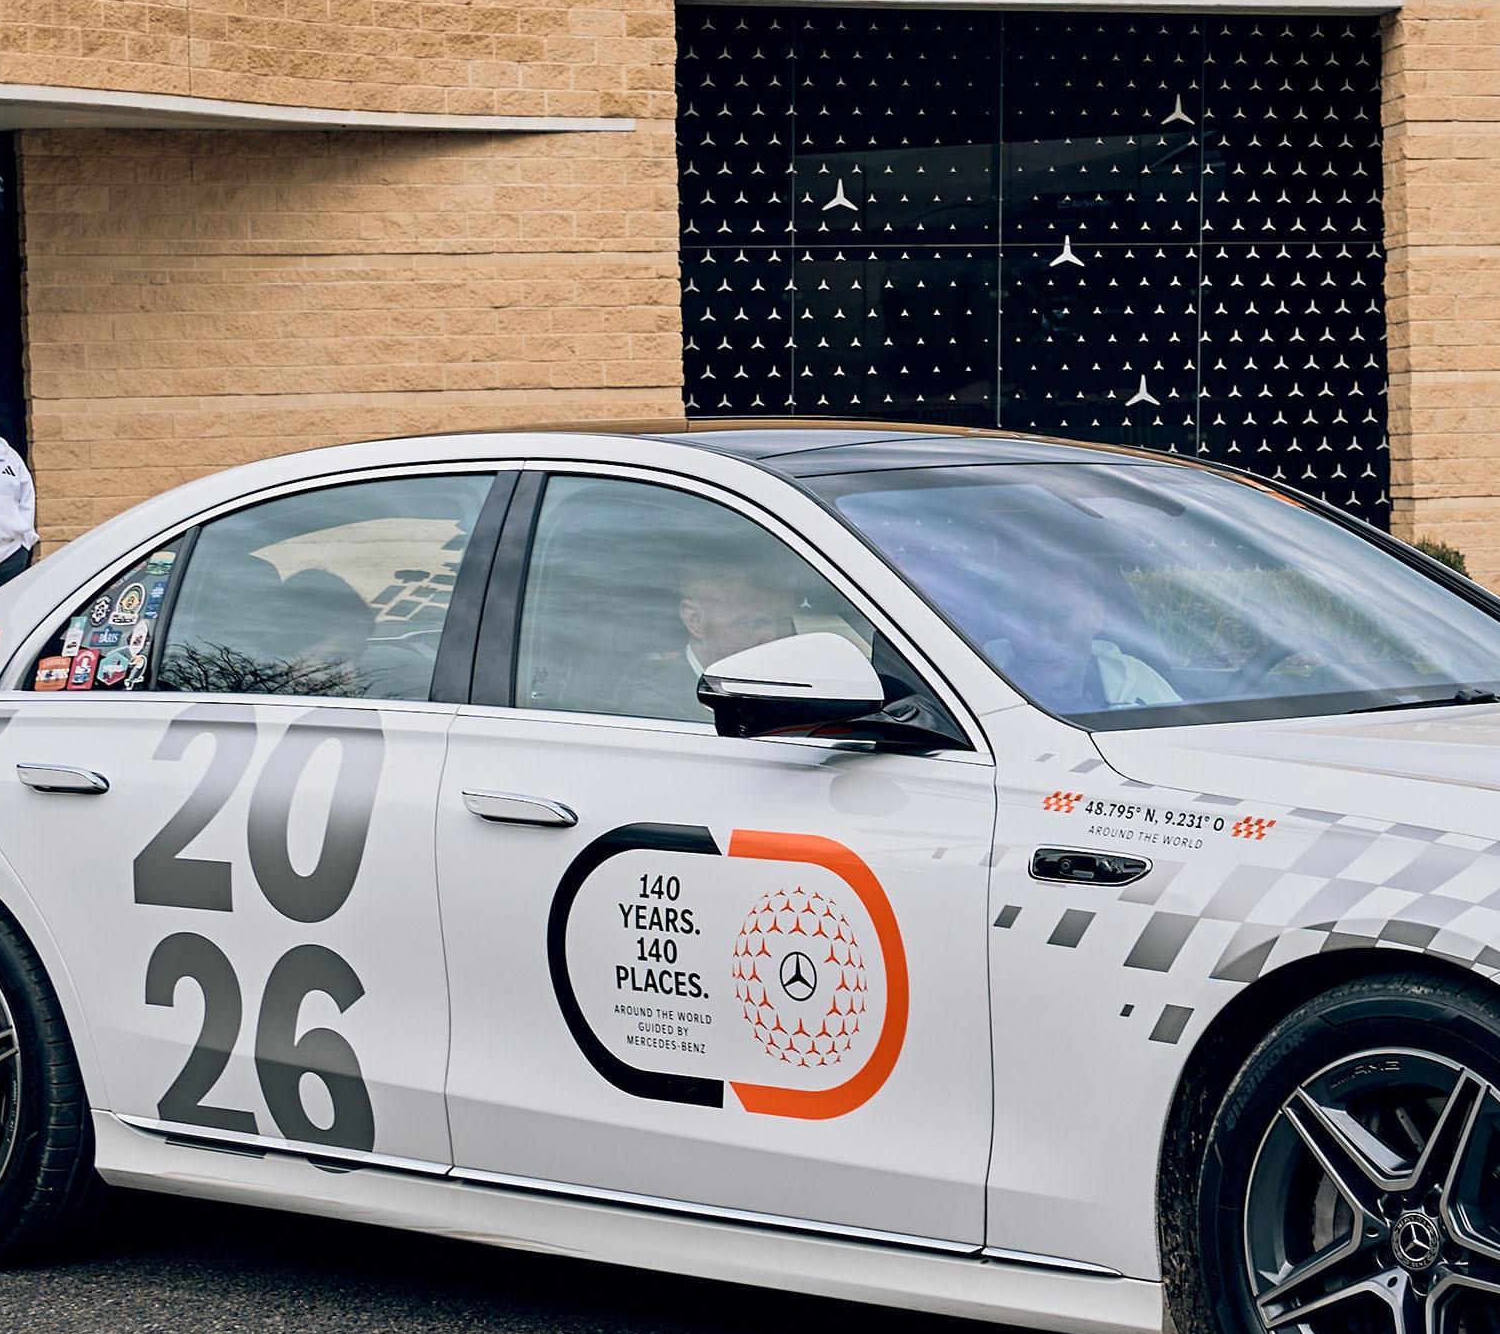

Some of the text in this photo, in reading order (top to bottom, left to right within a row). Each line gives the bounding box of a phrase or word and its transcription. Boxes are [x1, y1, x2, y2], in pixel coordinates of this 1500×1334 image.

[133, 702, 386, 924] 20
[1085, 800, 1225, 831] 48.795° N, 9.231° O
[1087, 825, 1204, 849] AROUND THE WORLD
[639, 873, 681, 902] 140
[618, 903, 701, 936] YEARS.
[636, 936, 678, 965] 140
[615, 965, 710, 999] PLACES.
[614, 1004, 712, 1025] AROUND THE WORLD
[637, 1021, 689, 1036] GUIDED BY
[145, 931, 376, 1173] 26
[626, 1034, 706, 1054] MERCEDES-BENZ
